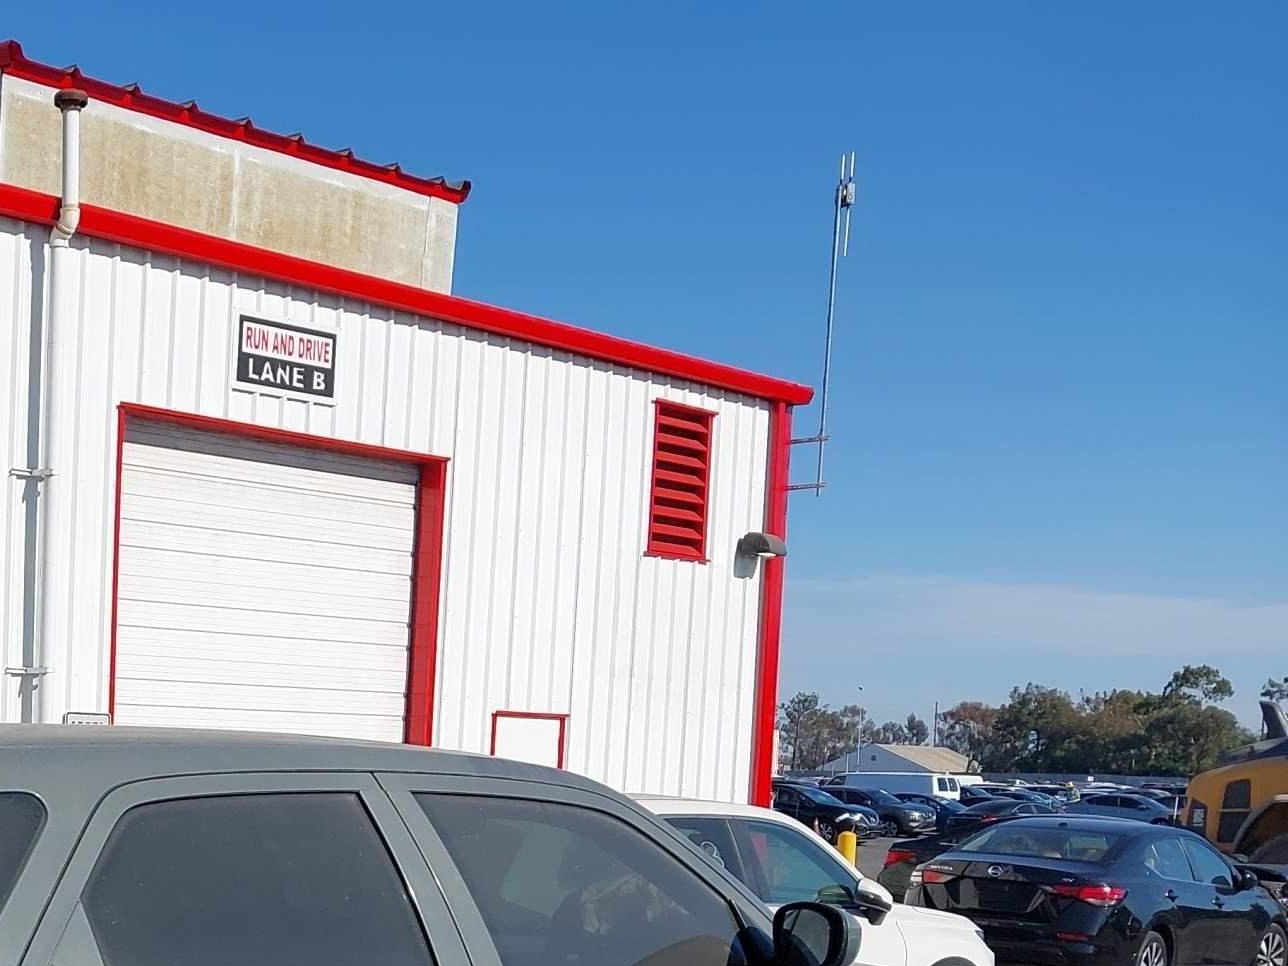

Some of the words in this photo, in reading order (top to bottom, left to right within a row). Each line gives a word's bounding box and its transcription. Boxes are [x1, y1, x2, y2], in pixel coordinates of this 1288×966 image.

[245, 326, 269, 352] RUN
[272, 332, 295, 357] AND
[298, 337, 330, 363] DRIVE
[248, 357, 305, 389] LANE
[312, 370, 326, 391] B
